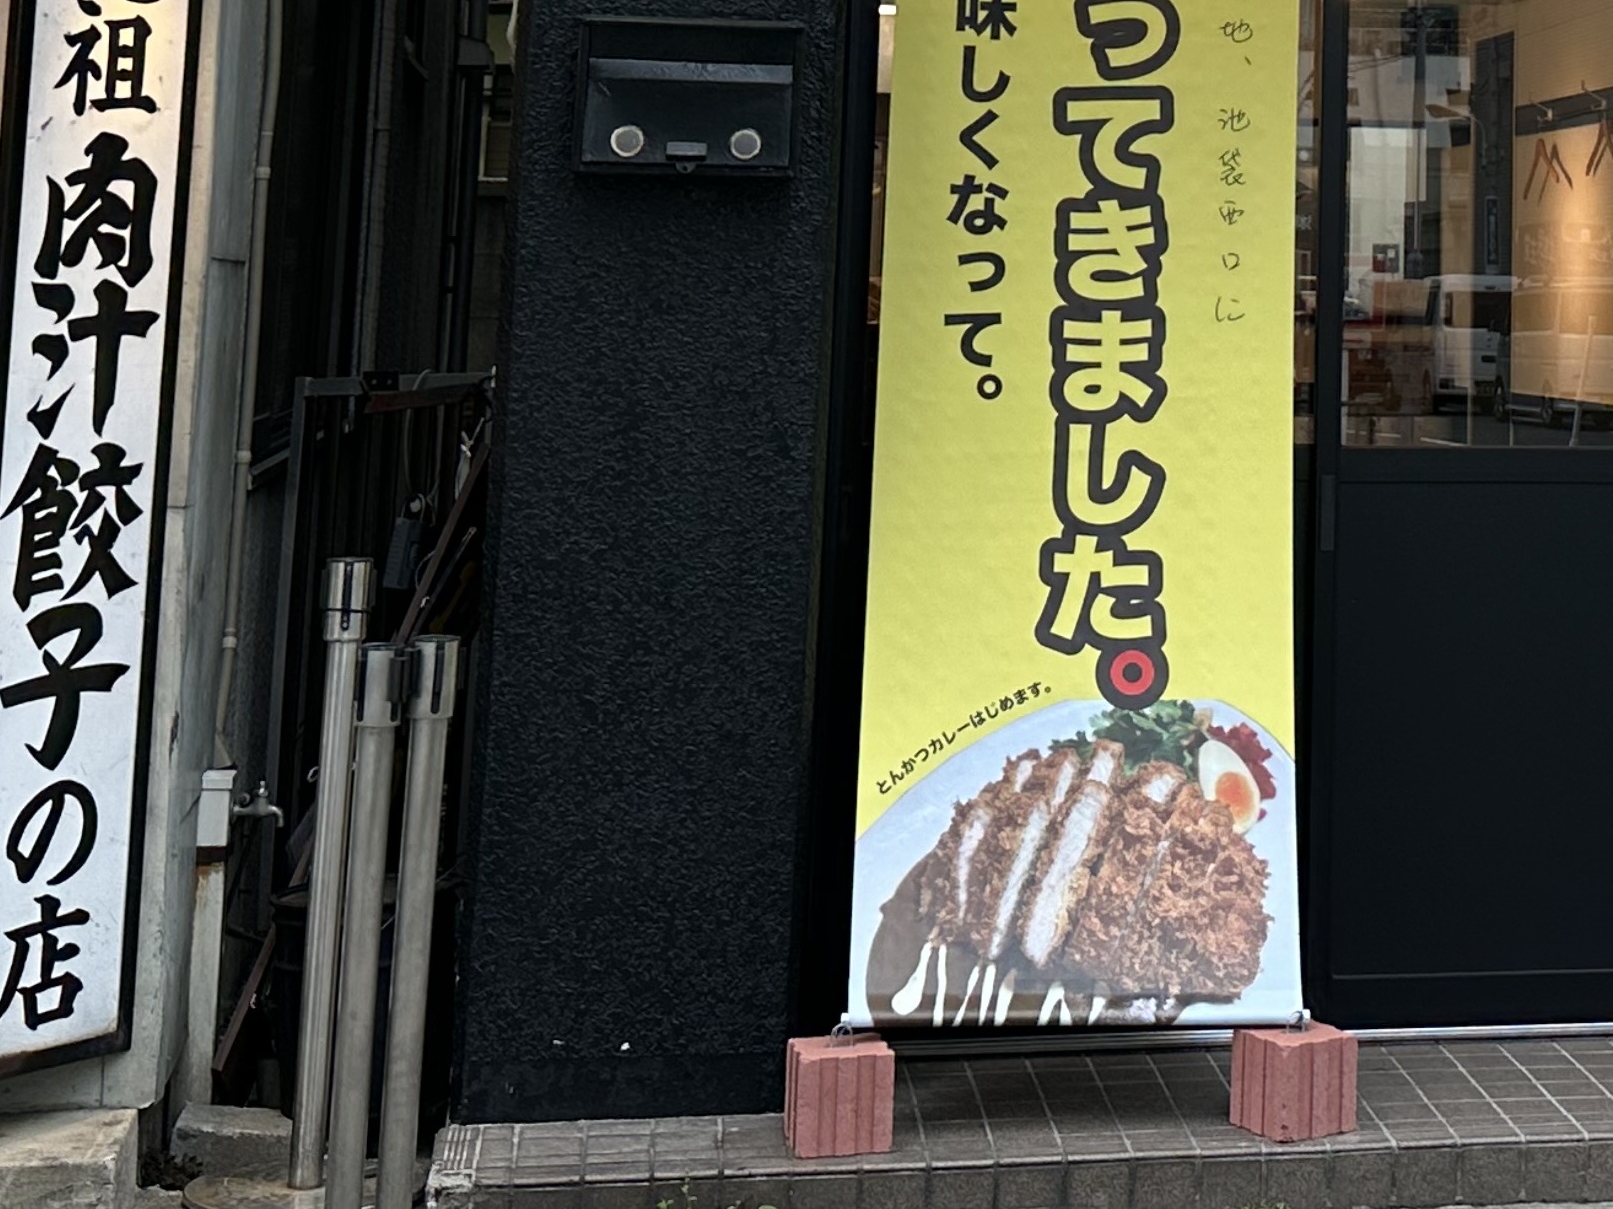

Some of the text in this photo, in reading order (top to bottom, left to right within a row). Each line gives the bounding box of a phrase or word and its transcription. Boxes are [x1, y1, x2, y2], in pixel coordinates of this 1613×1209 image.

[875, 681, 1052, 795] とんかつカレーはじめます。
